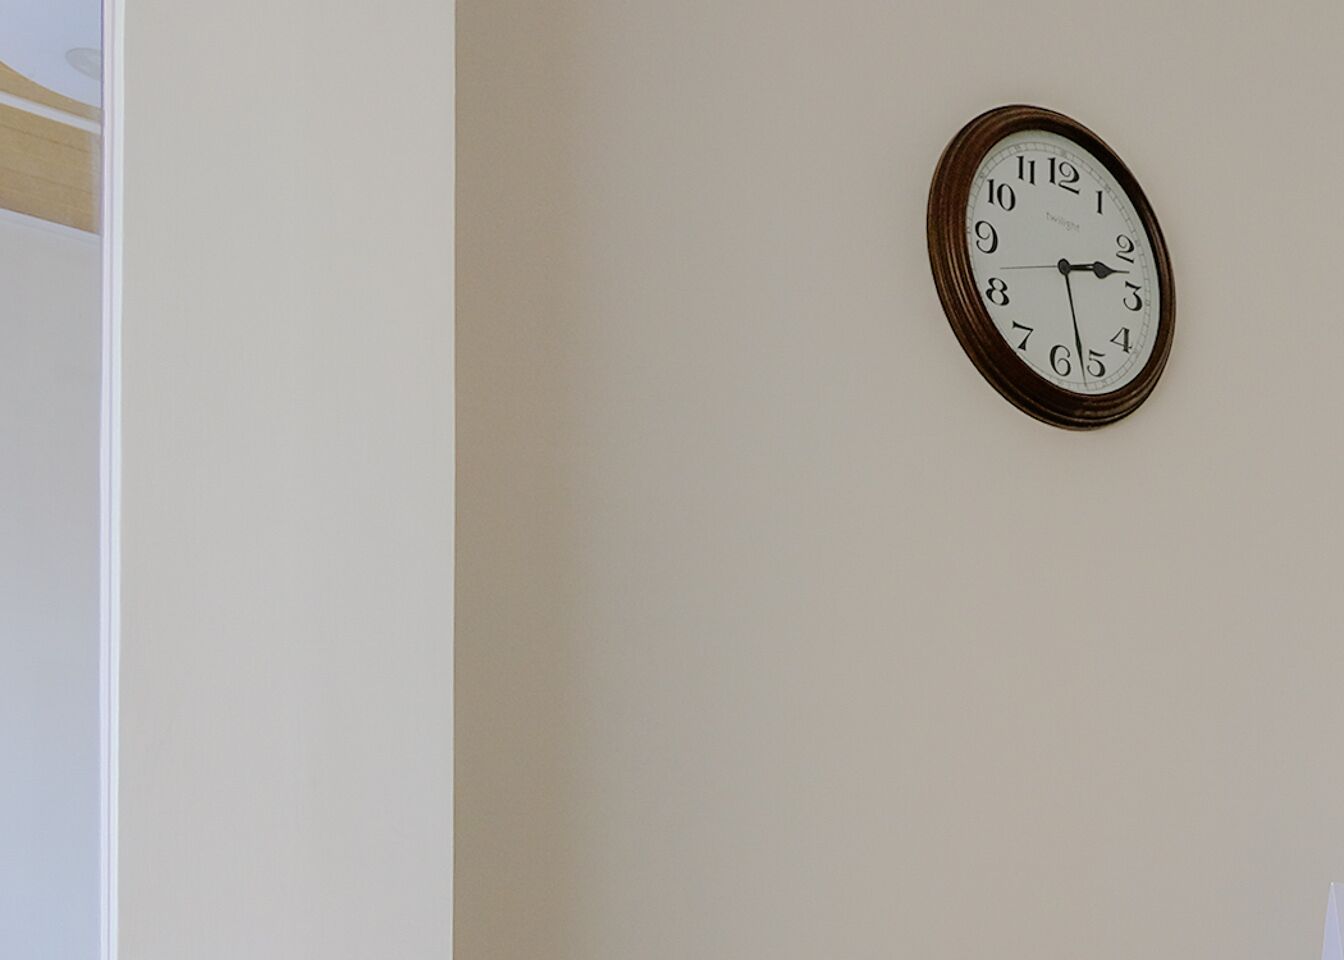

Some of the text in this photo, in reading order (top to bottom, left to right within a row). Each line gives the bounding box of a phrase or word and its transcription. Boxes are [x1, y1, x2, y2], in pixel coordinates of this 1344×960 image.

[1016, 155, 1036, 185] 11
[1047, 157, 1080, 195] 12
[987, 178, 1016, 212] 10
[1096, 190, 1103, 215] 1
[974, 220, 998, 254] 9
[1116, 234, 1135, 264] 2
[985, 277, 1010, 307] 8
[1122, 280, 1143, 312] 3
[1012, 320, 1034, 351] 7
[1110, 327, 1133, 353] 4
[1049, 344, 1072, 377] 6
[1087, 349, 1106, 377] 5
